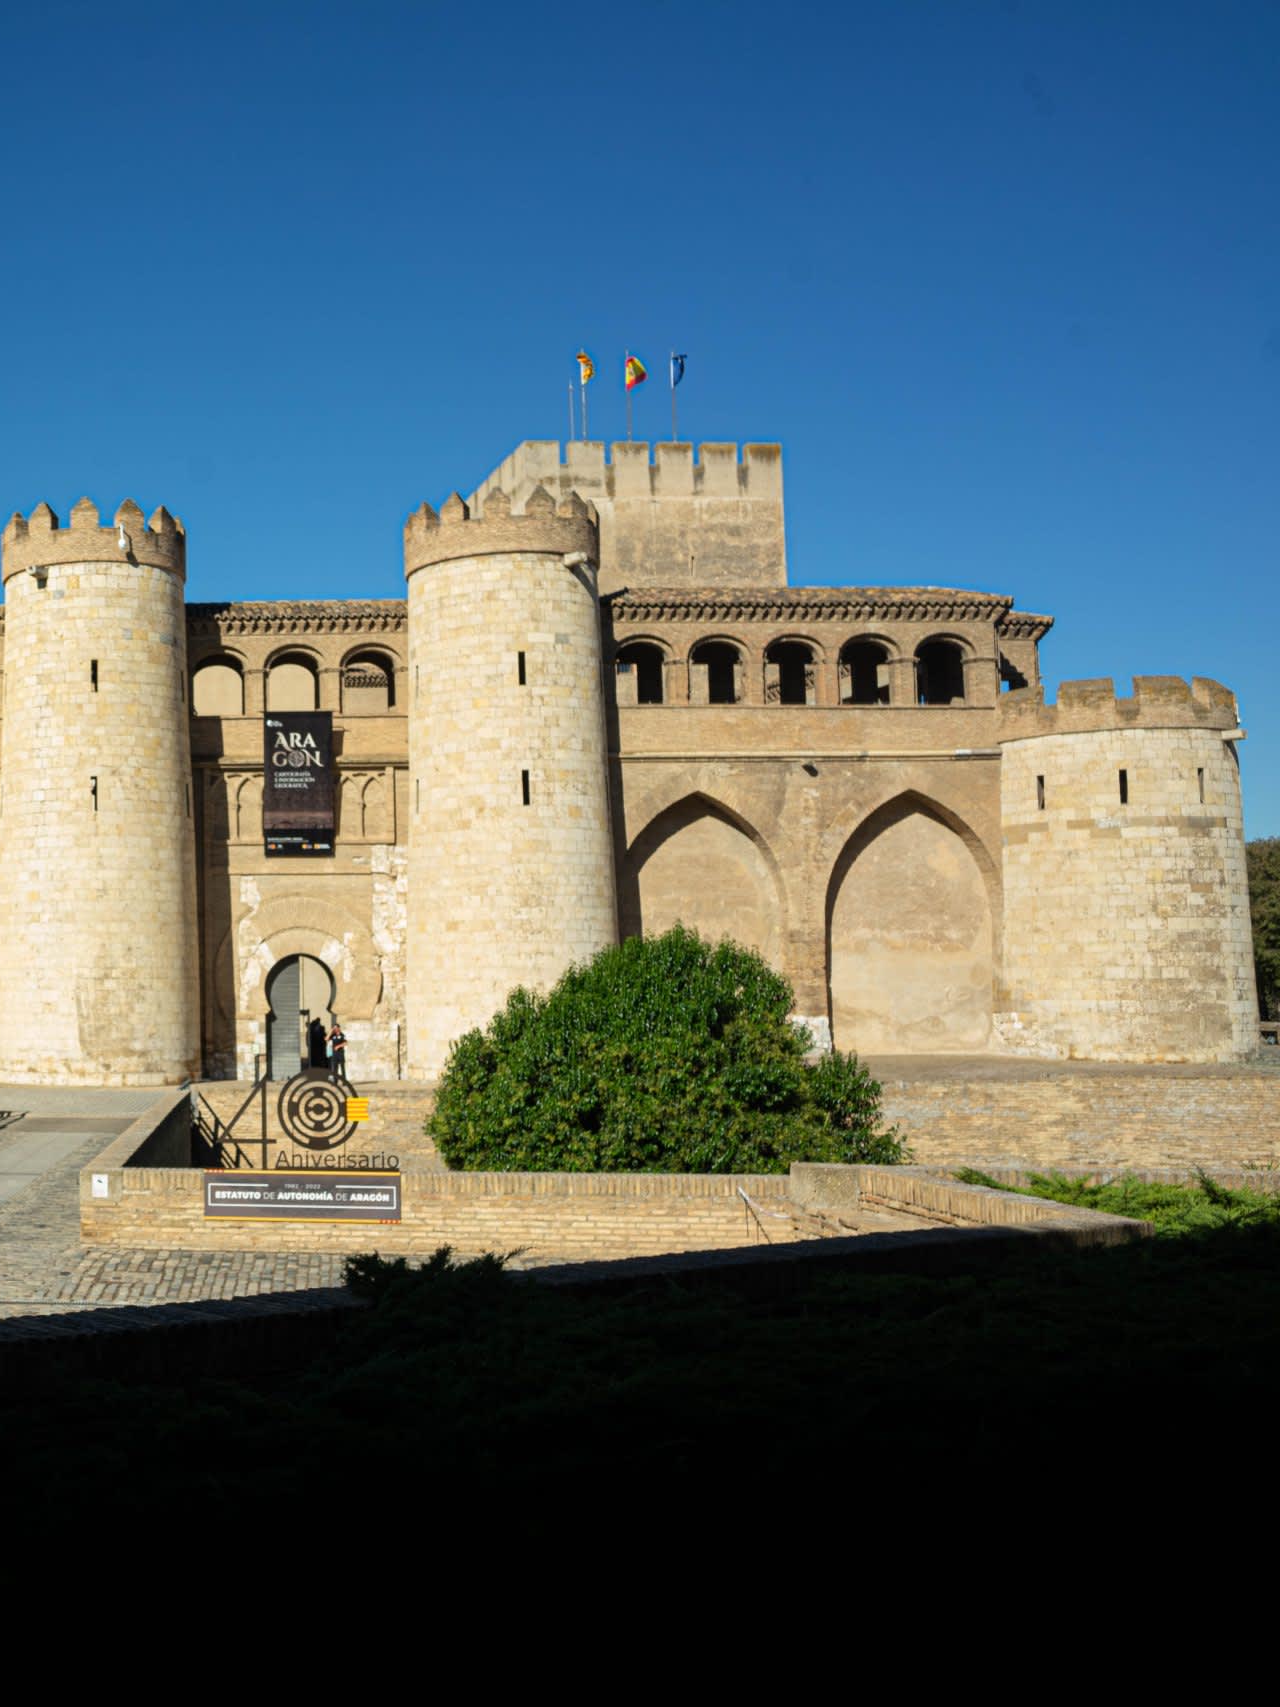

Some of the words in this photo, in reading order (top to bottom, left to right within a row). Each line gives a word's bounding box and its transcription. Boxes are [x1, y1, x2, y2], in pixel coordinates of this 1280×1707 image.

[274, 732, 317, 749] ARA
[275, 1150, 400, 1169] Aniversario
[215, 1191, 261, 1200] ESTATUTO
[263, 1191, 276, 1200] DE
[277, 1190, 333, 1201] AUTONOMÍA
[335, 1193, 348, 1201] DE
[350, 1192, 389, 1202] ARAGÓN
